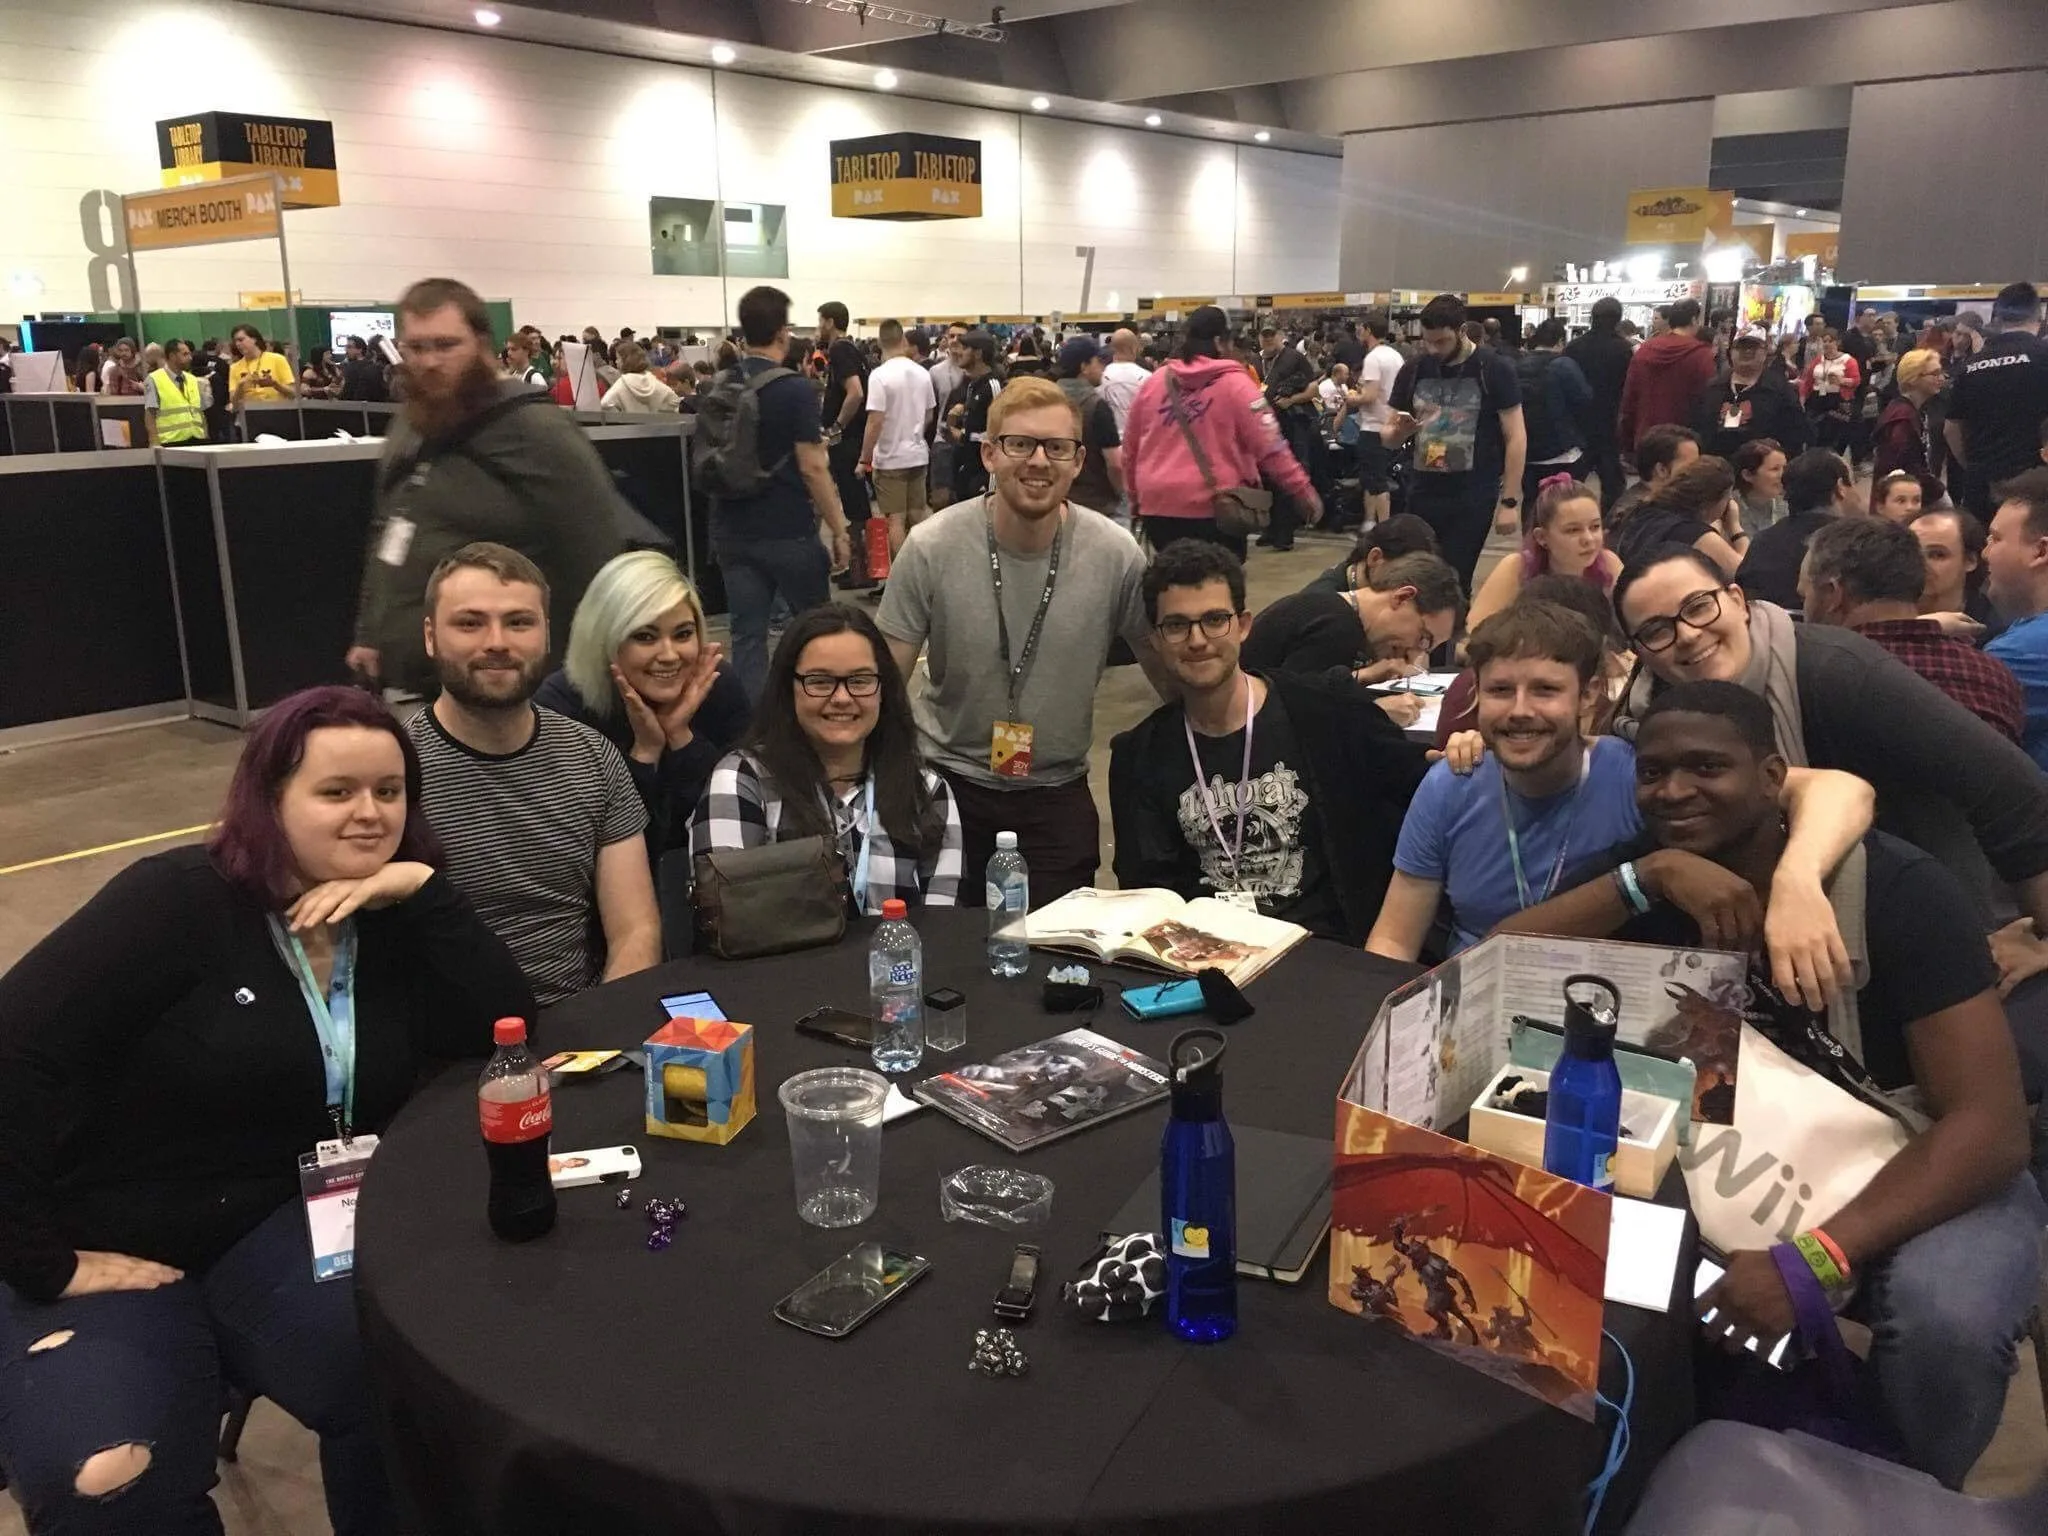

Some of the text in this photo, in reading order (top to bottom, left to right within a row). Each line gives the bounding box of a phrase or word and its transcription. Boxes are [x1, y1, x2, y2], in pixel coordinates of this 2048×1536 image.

[169, 123, 203, 148] TABLETOP
[243, 122, 308, 149] TABLETOP
[173, 145, 204, 168] LIBRARY
[251, 146, 306, 169] LIBRARY
[835, 151, 901, 184] TABLETOP
[914, 150, 976, 184] TABLETOP
[853, 188, 883, 205] PAX
[931, 187, 960, 204] PAX
[156, 206, 197, 229] MERCH
[199, 199, 243, 223] BOOTH
[246, 191, 275, 215] PAX
[80, 189, 140, 314] 8
[1966, 353, 2031, 374] HONDA
[1679, 1129, 1812, 1241] Wii
